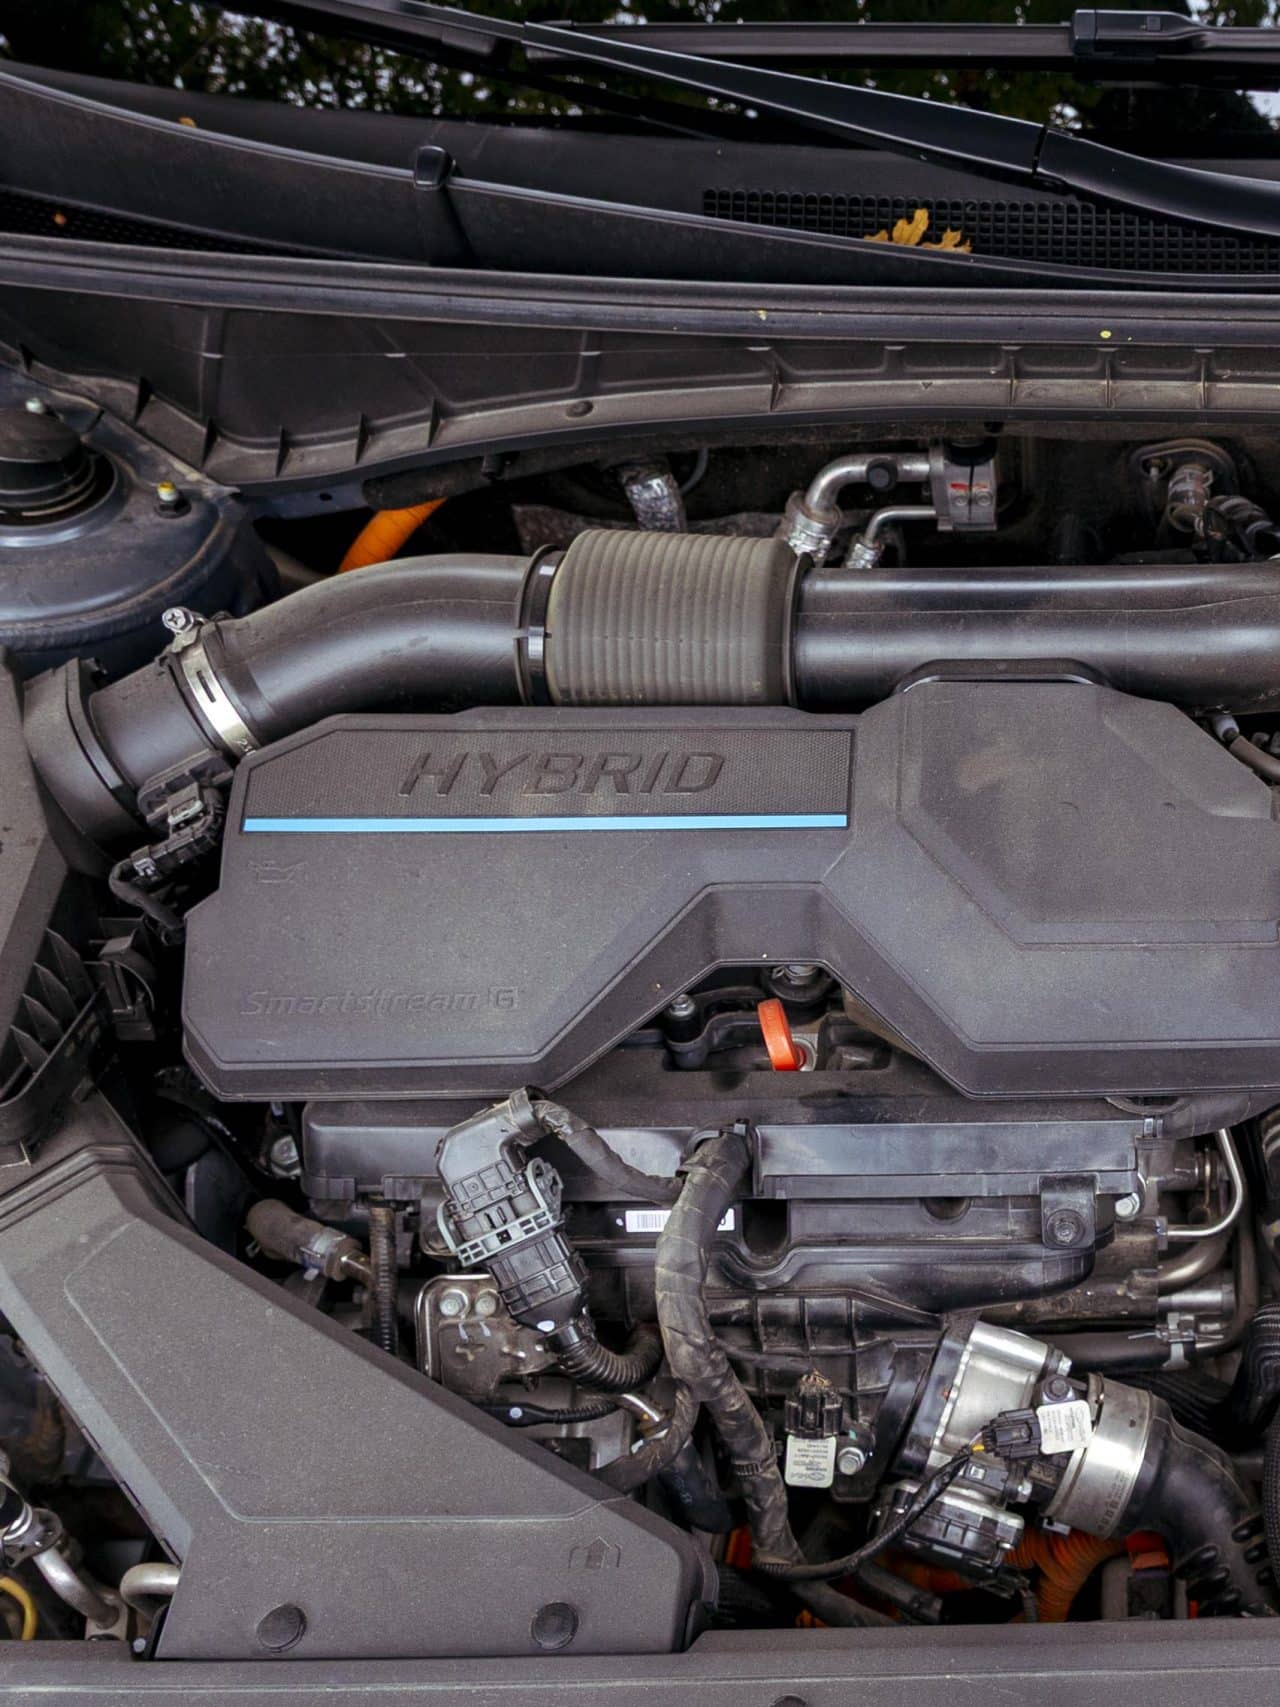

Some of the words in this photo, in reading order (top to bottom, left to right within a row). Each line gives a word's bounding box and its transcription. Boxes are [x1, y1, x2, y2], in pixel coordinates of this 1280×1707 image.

[398, 751, 725, 797] HYBRID
[240, 989, 480, 1017] Smartstream
[492, 987, 516, 1009] G
